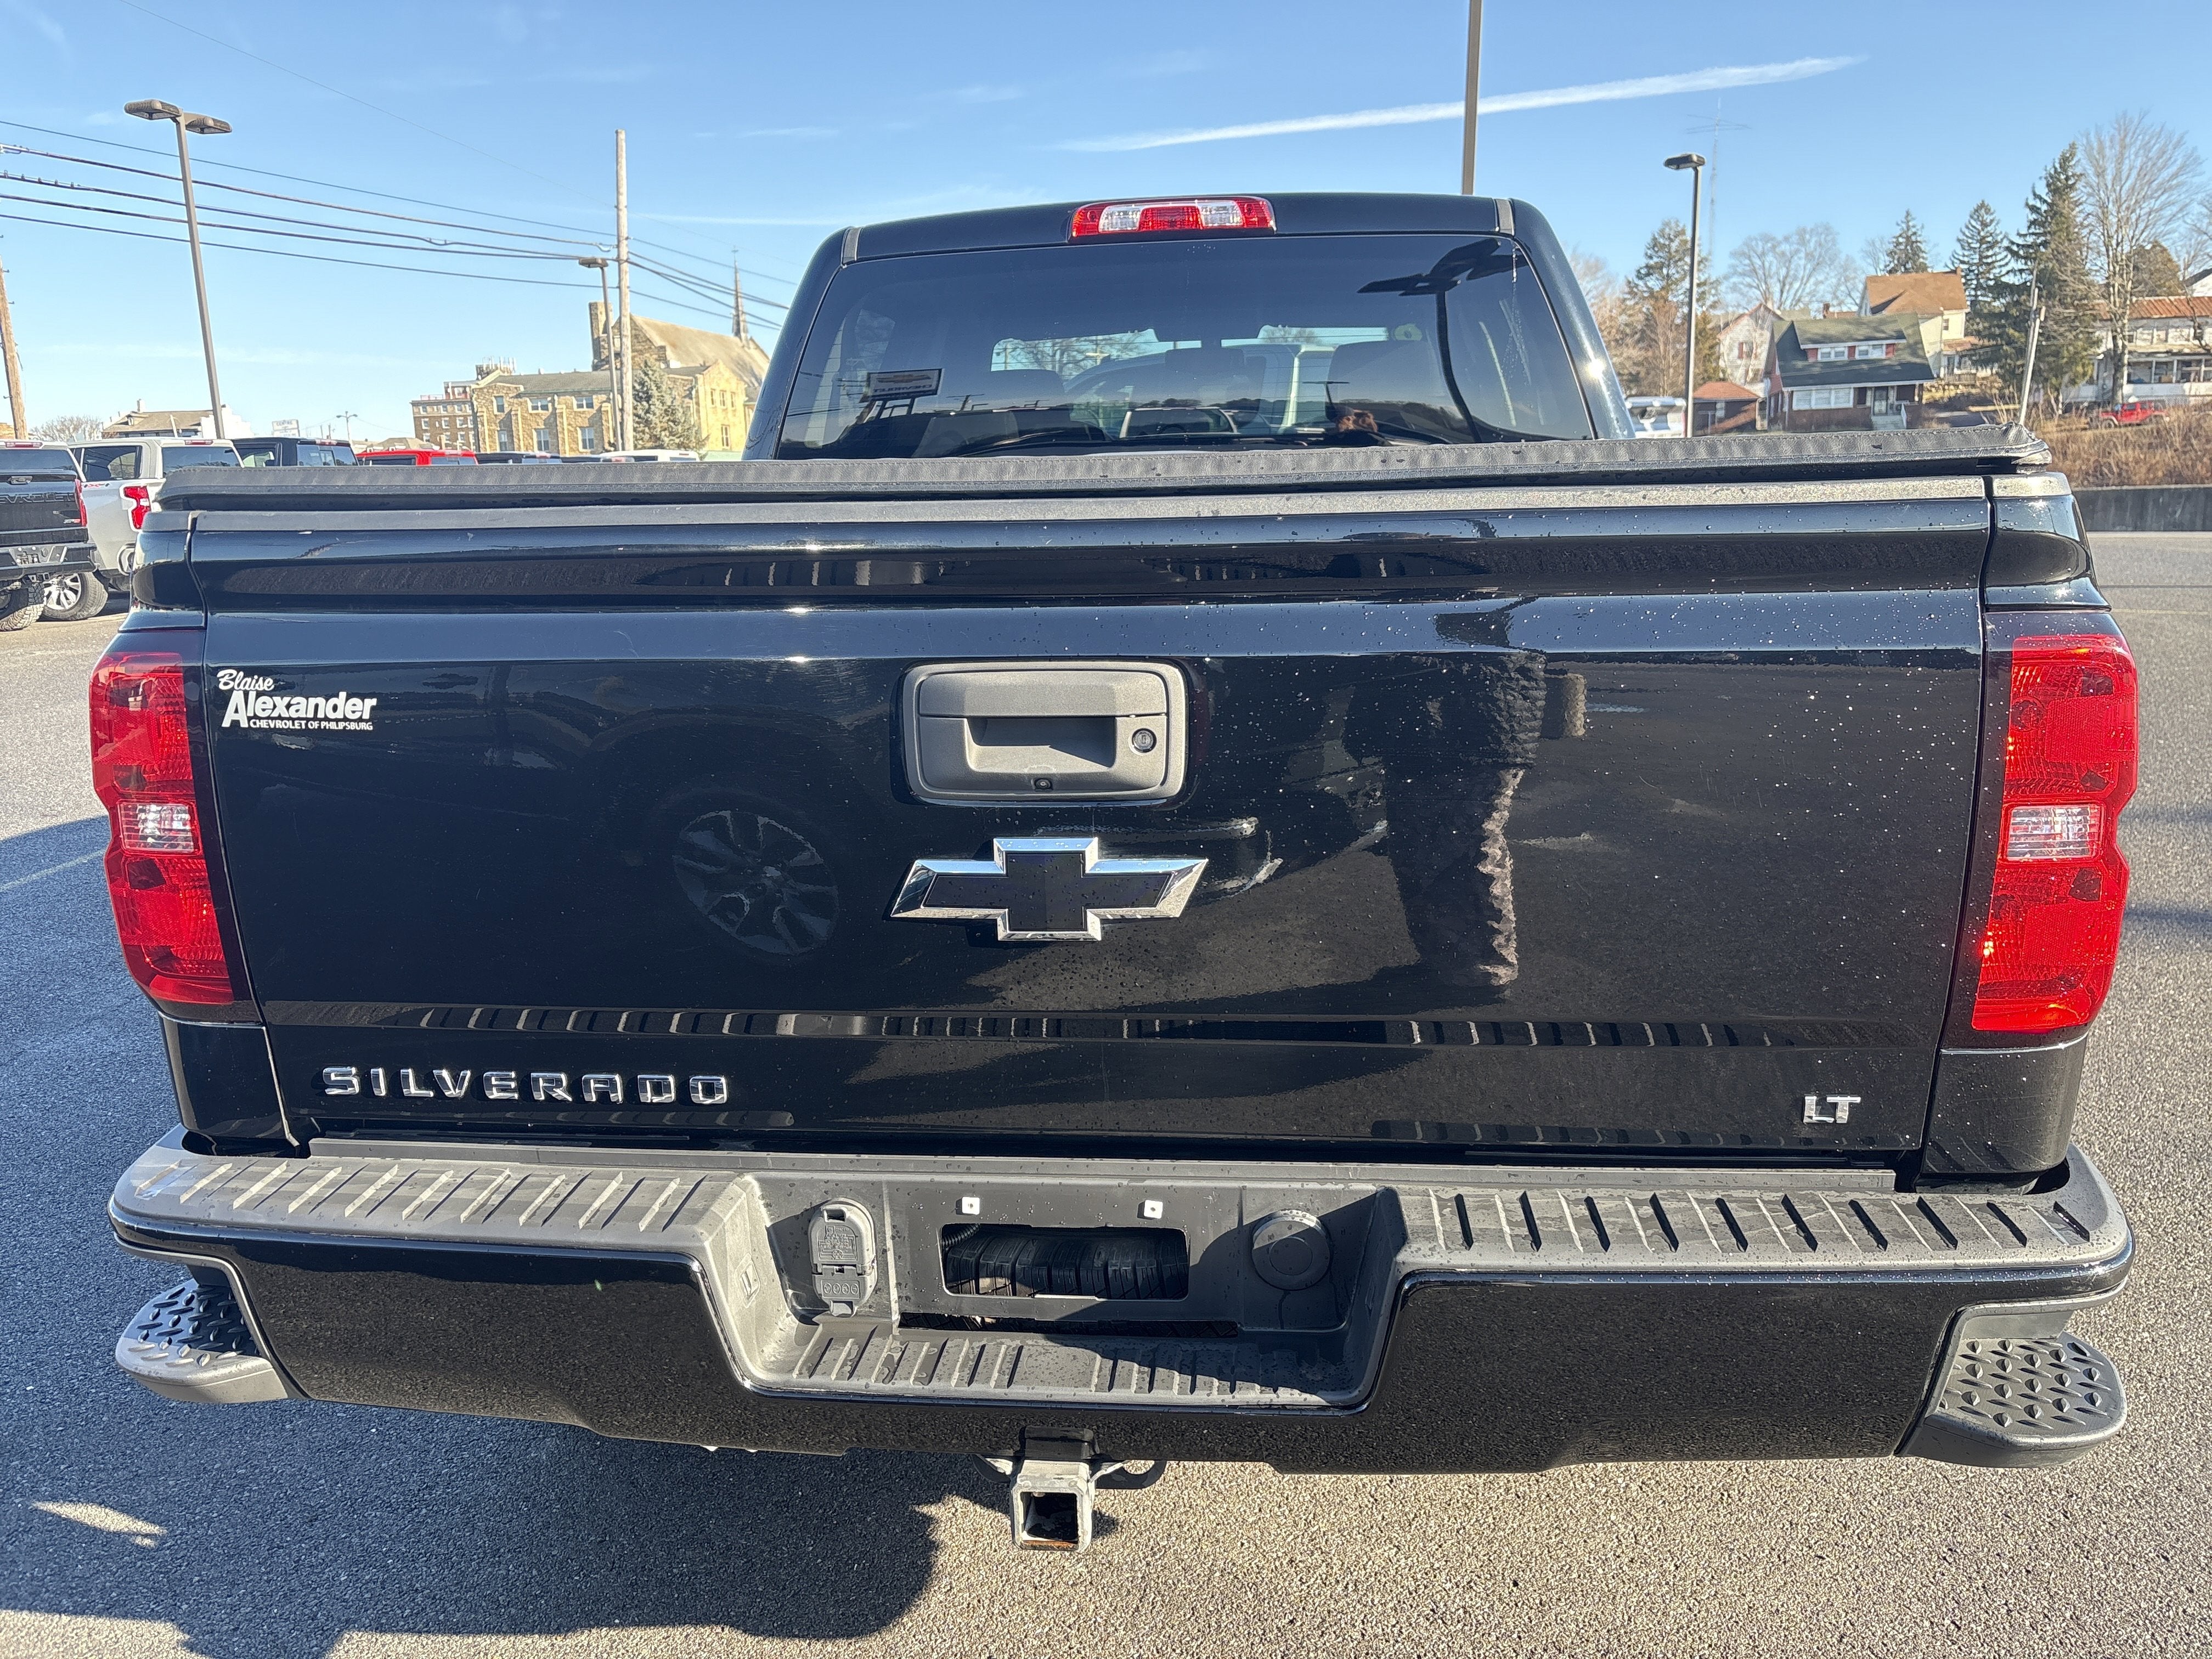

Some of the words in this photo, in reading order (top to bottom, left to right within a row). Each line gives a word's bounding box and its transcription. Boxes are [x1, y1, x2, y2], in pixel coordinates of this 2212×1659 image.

[217, 669, 274, 691] Blaise
[222, 691, 377, 727] Alexander
[250, 719, 307, 729] CHEVROLET
[308, 720, 320, 730] OF
[320, 721, 373, 731] PHILIPSBURG
[322, 1065, 727, 1105] SILVERADO
[1803, 1095, 1861, 1124] LT
